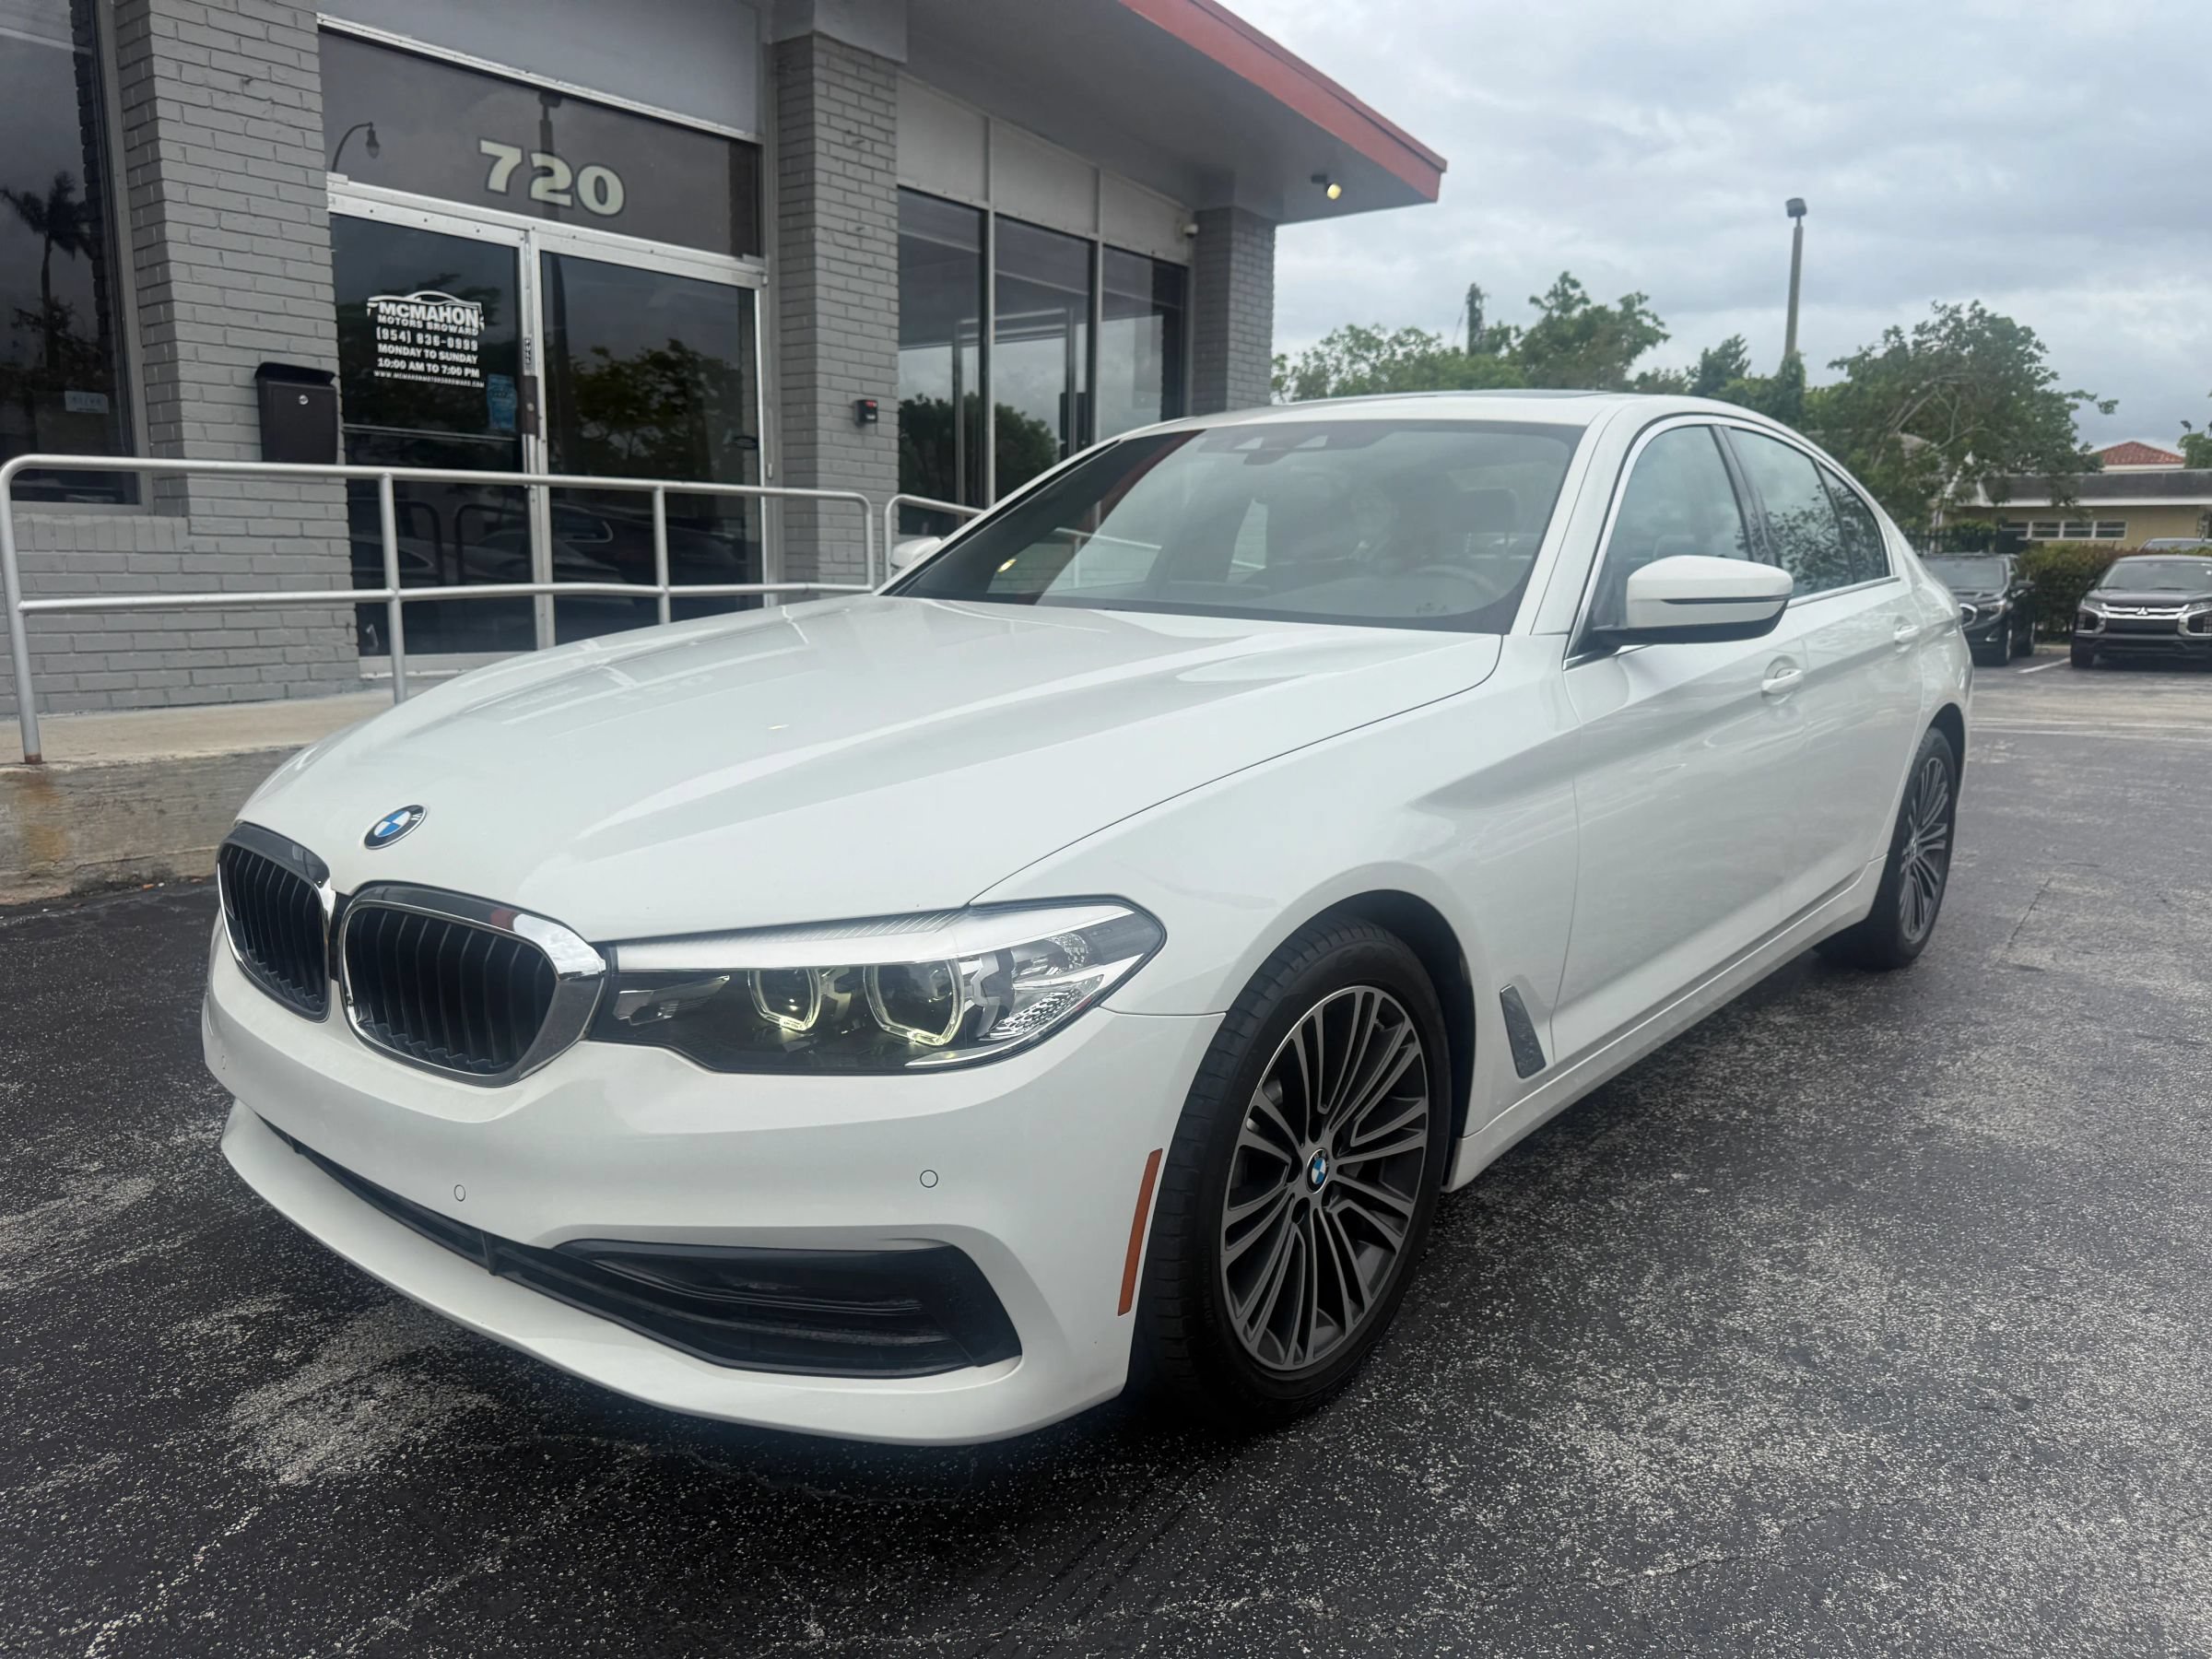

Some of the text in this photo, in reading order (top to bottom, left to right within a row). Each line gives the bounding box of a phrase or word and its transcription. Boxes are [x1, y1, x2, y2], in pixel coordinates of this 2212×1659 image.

[478, 138, 626, 217] 720
[377, 314, 478, 336] MOTORS BROWARD
[379, 301, 478, 329] MCMAHON
[377, 343, 478, 364] MONDAY TO SUNDAY
[377, 358, 480, 378] 10:00 AM TO 7:00 PM
